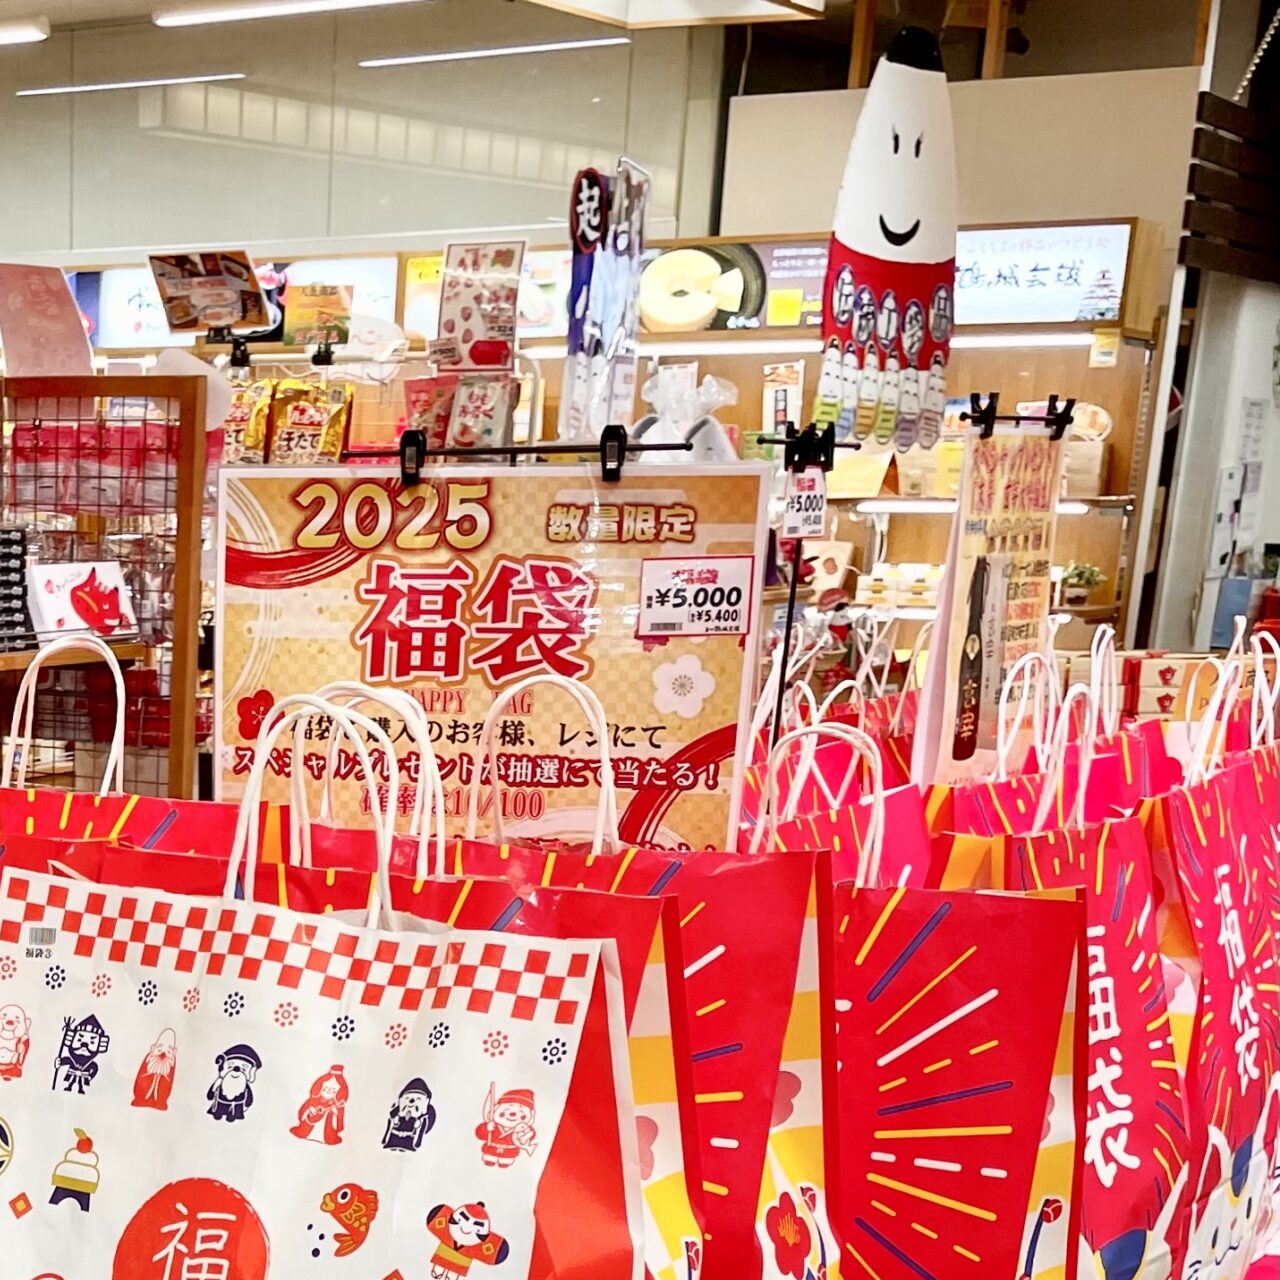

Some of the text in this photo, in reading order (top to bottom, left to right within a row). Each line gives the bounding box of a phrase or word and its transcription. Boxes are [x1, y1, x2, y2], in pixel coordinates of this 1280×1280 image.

[296, 482, 493, 552] 2025
[547, 502, 698, 545] 数量限定
[358, 559, 592, 684] 福袋
